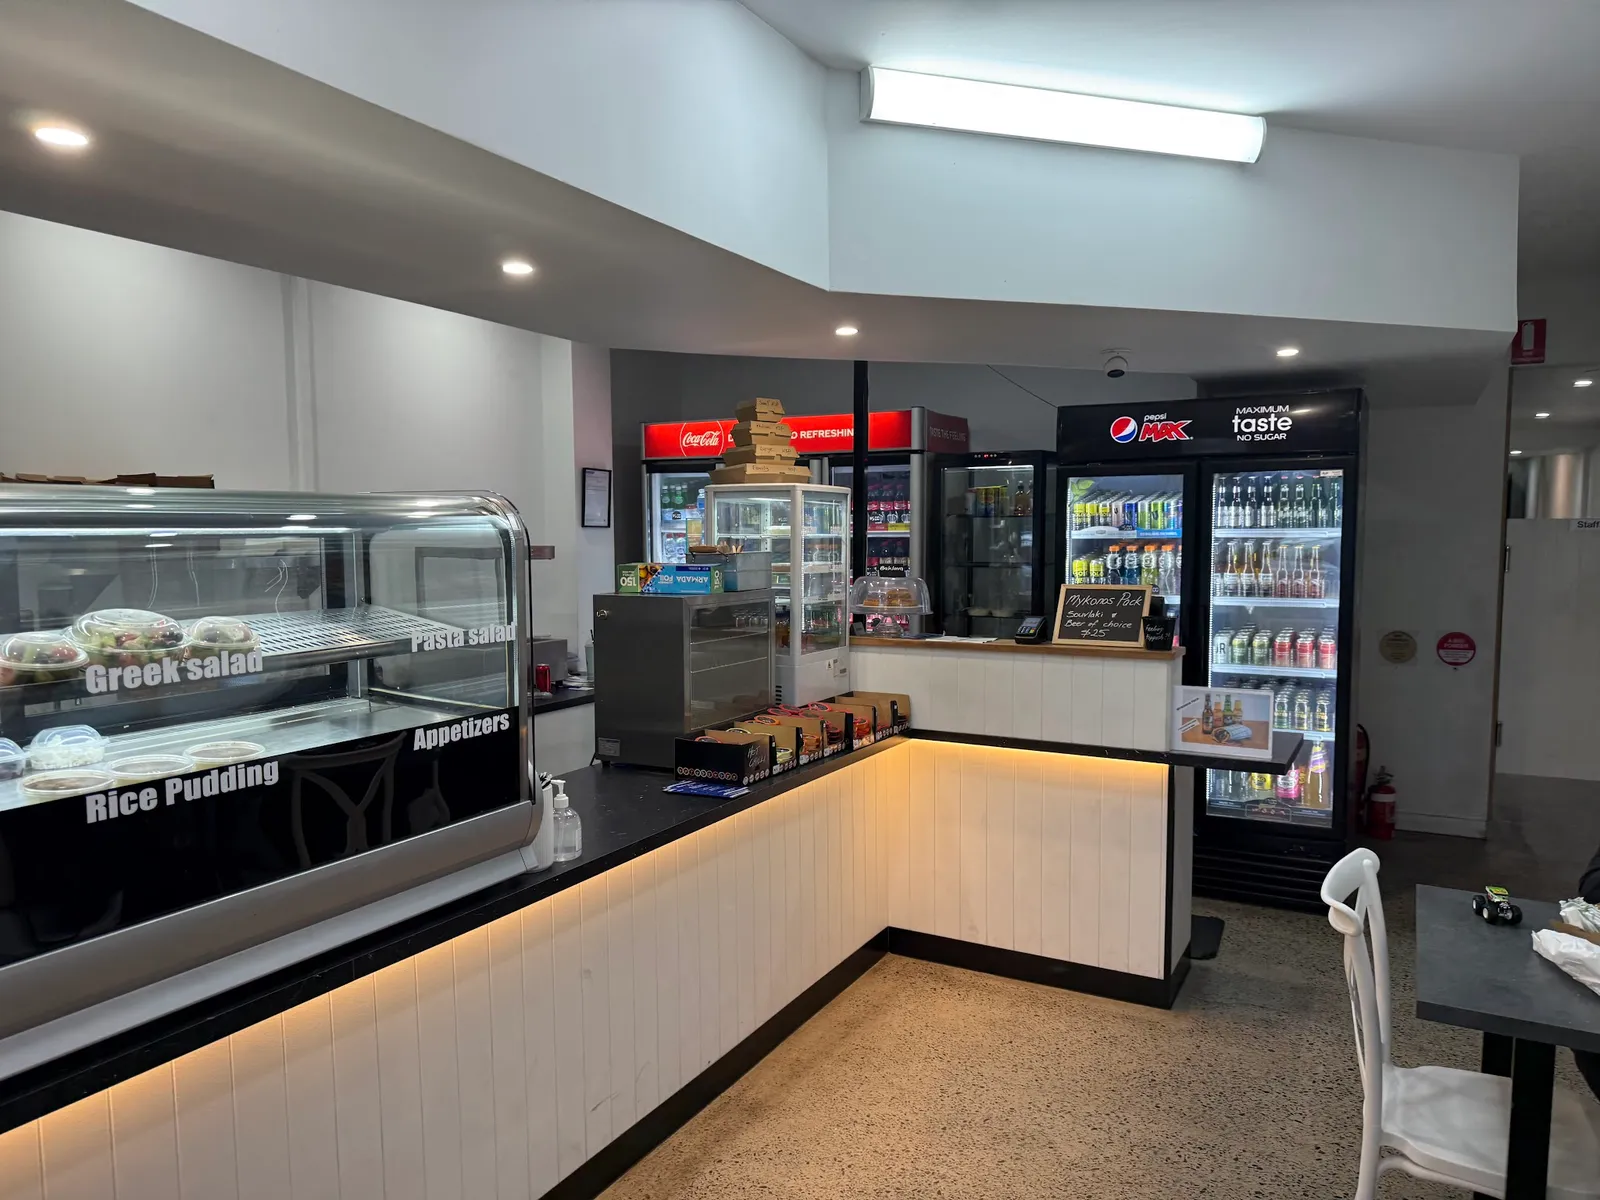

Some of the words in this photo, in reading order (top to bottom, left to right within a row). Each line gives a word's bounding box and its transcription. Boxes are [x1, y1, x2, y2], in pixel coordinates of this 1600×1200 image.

[1235, 405, 1290, 414] MAXIMUM
[1144, 413, 1167, 421] pepsi
[1232, 413, 1292, 433] taste
[800, 428, 854, 439] REFRESHIN
[1139, 420, 1193, 442] MAX
[1254, 433, 1287, 441] SUGAR
[683, 431, 721, 447] Coca-Cola
[620, 576, 637, 587] 150
[676, 576, 709, 584] ARMADA
[1065, 594, 1116, 608] Mykonos
[1117, 592, 1142, 607] Pack
[1066, 610, 1104, 619] Souvlaki
[1064, 620, 1086, 628] Beer
[1088, 620, 1097, 628] of
[1103, 620, 1133, 629] choice
[412, 627, 465, 652] Pasta
[469, 622, 518, 645] salad
[86, 657, 182, 694] Greek
[187, 647, 263, 680] salad
[413, 713, 510, 751] Appetizers
[86, 786, 158, 824] Rice
[165, 760, 279, 806] Pudding
